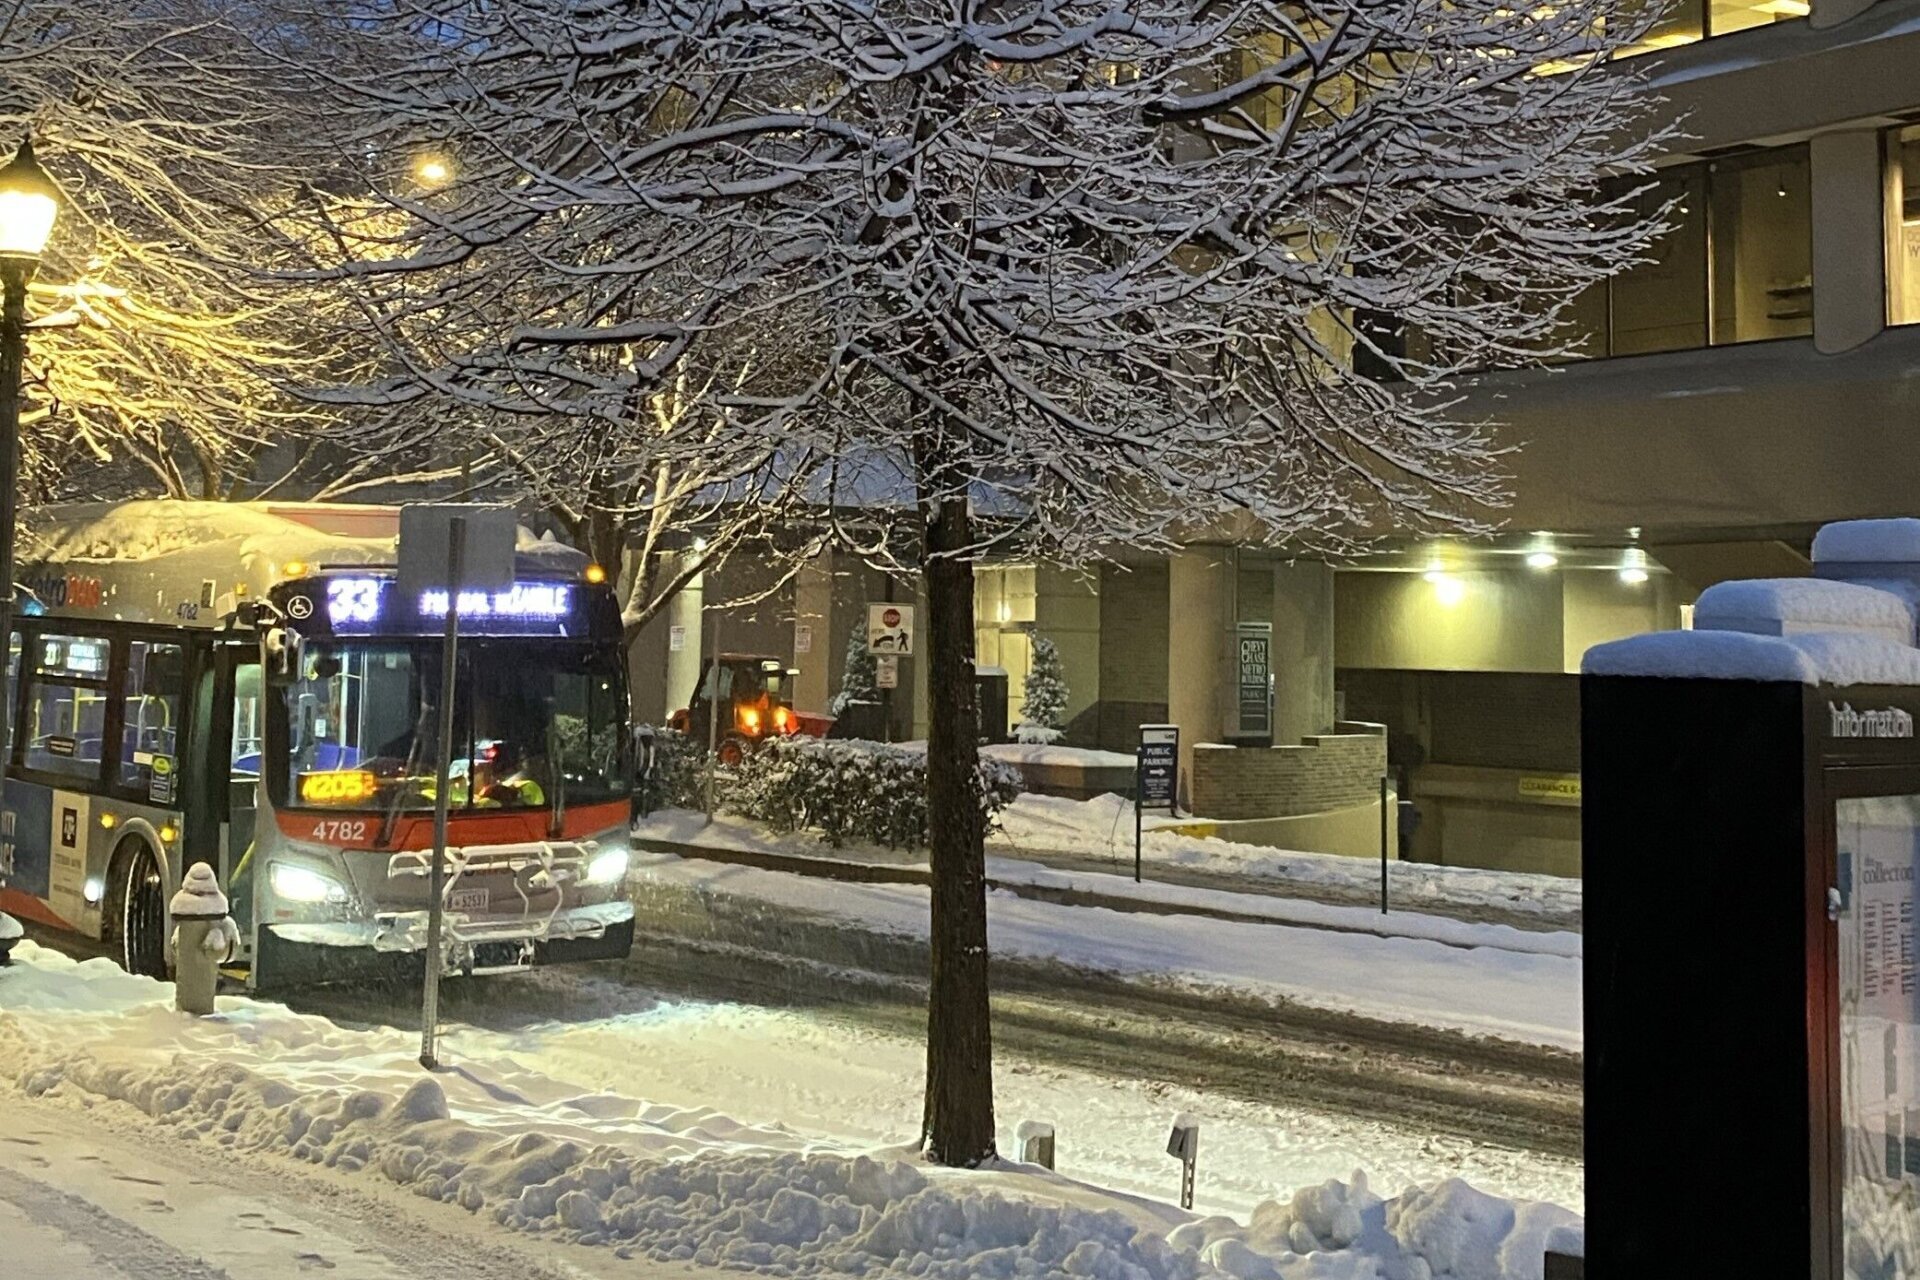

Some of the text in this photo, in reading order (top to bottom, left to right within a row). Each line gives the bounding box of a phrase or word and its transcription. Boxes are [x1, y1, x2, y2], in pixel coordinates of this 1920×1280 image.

[327, 579, 378, 621] 33
[1241, 640, 1267, 652] CHEVY
[1241, 651, 1267, 663] CHASE
[1241, 663, 1267, 675] METRO
[1832, 706, 1914, 738] Information
[1147, 747, 1171, 755] PUBLIC
[1143, 757, 1174, 767] PARKING
[1521, 782, 1569, 793] CLEARANCE
[312, 821, 365, 840] 4782
